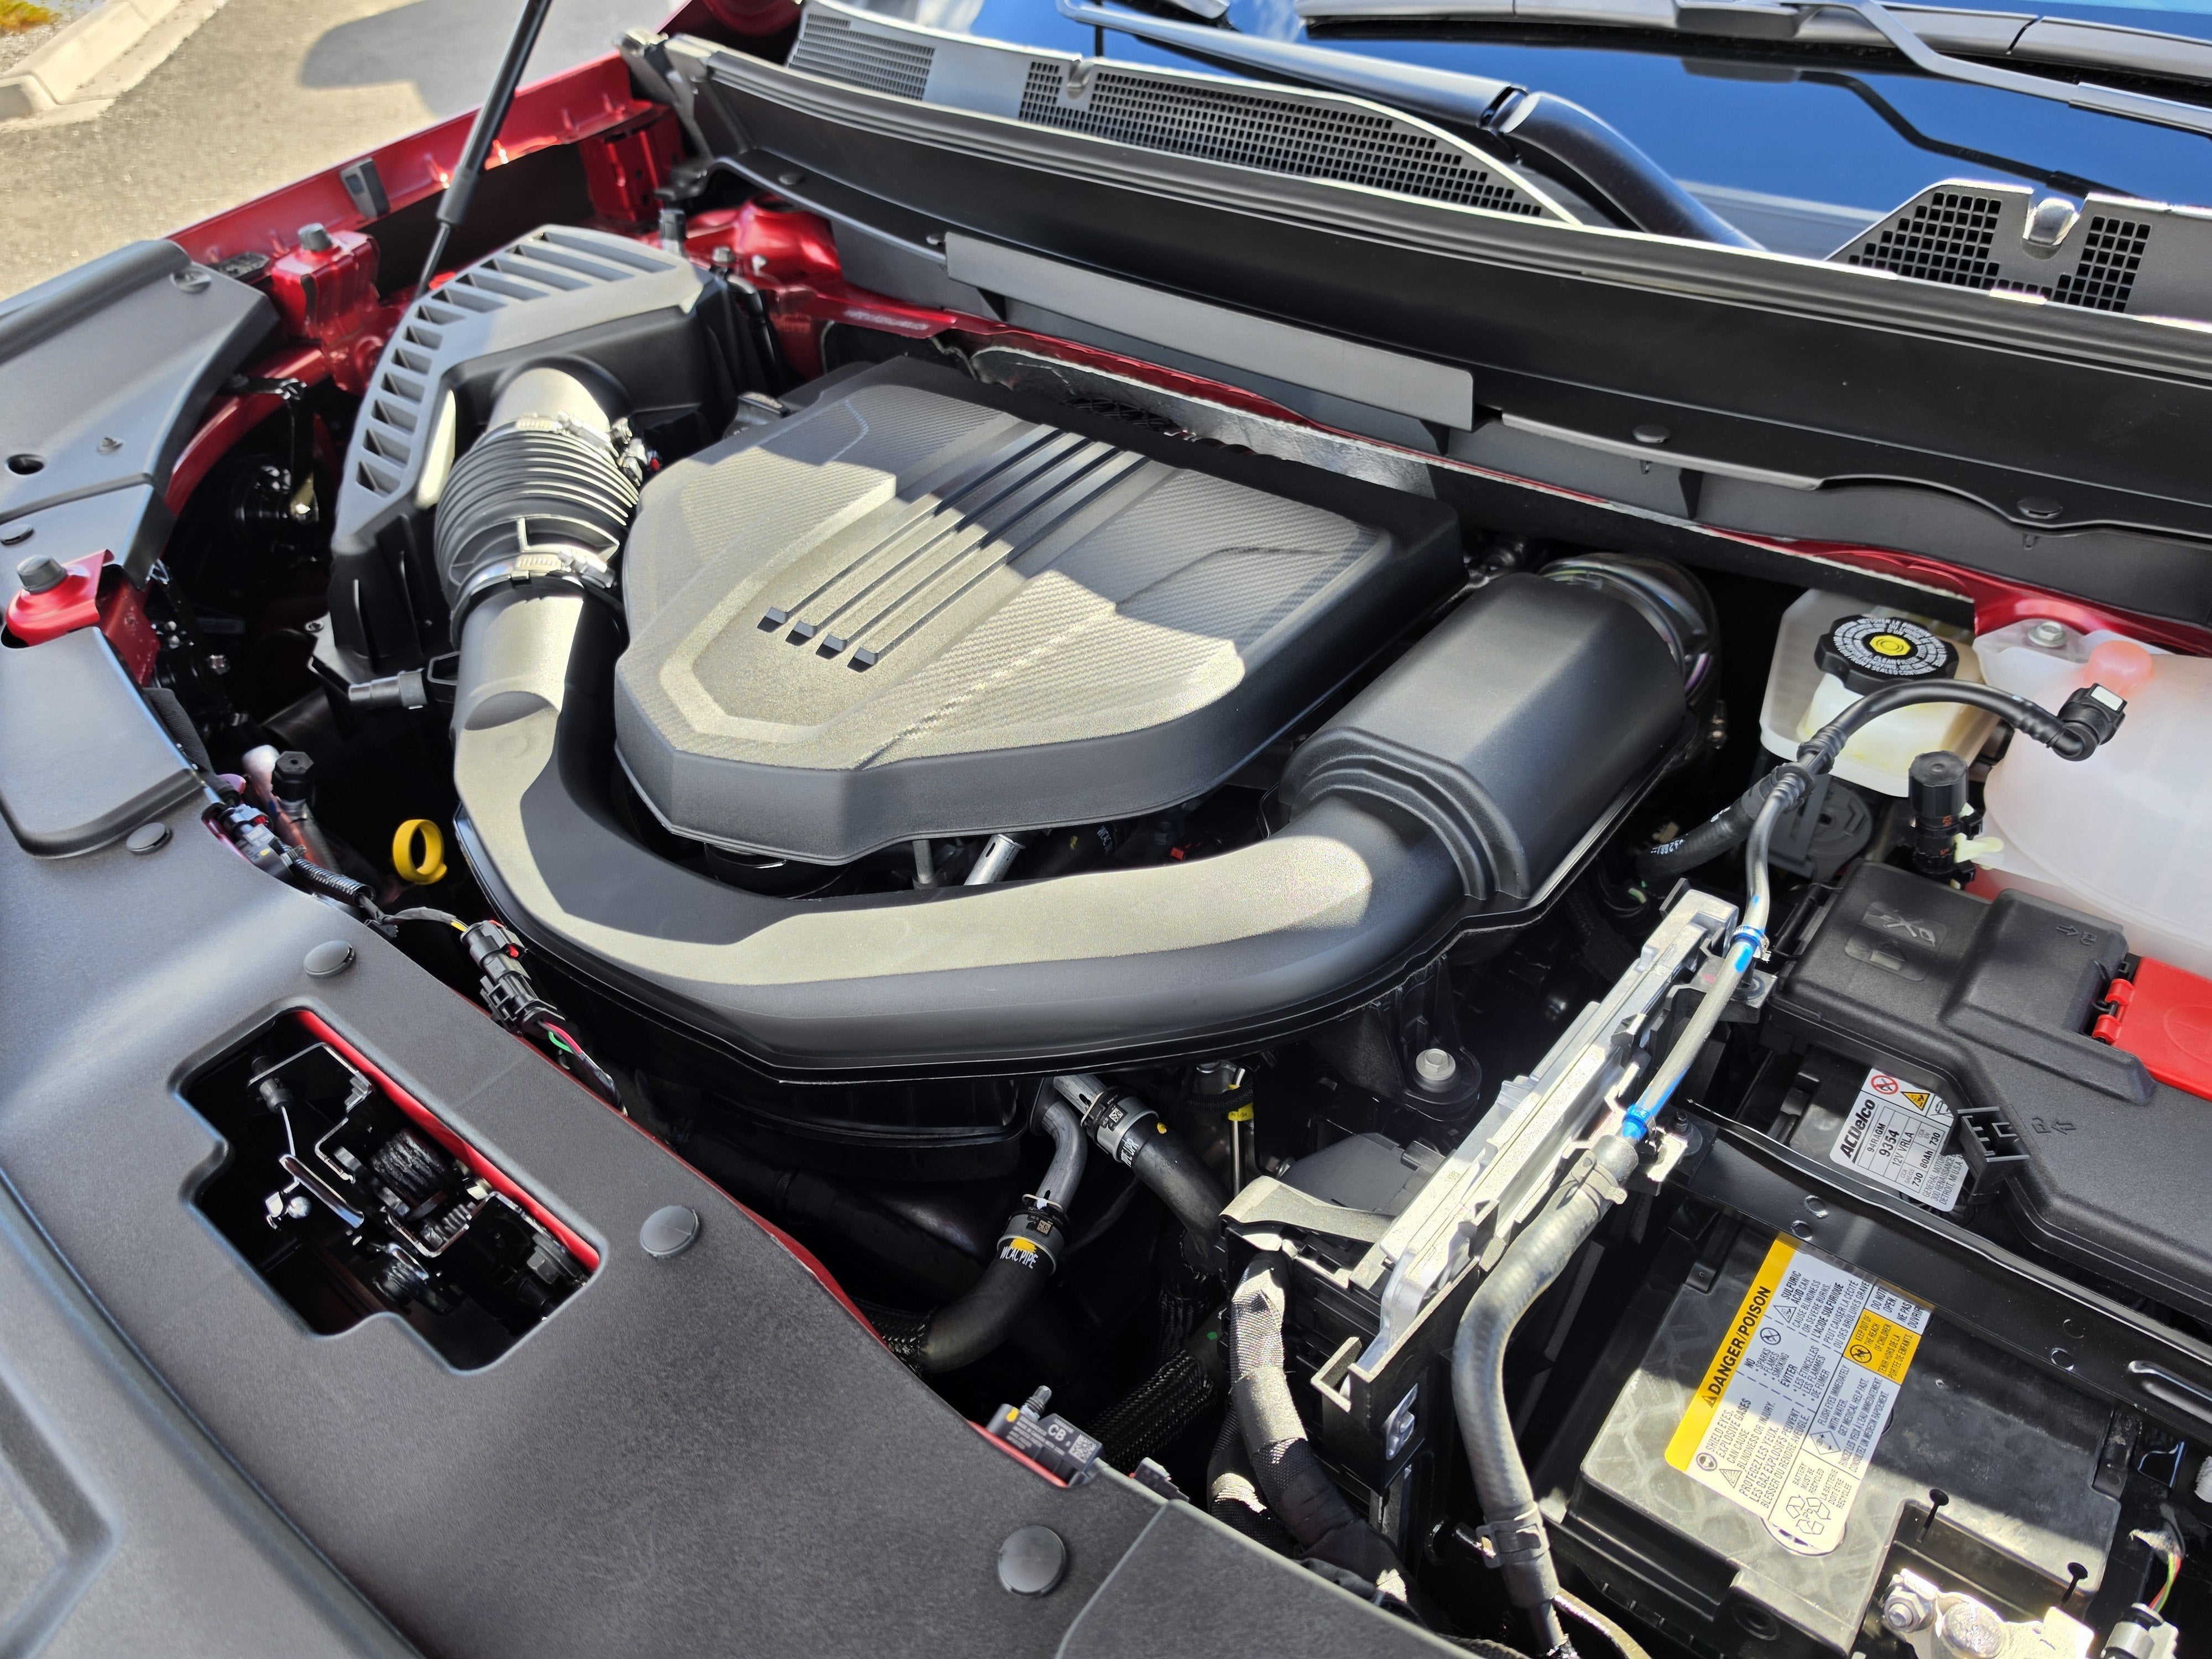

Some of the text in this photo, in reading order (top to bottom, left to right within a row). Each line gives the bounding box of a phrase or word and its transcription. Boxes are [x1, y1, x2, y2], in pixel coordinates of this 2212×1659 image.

[1871, 665, 1898, 675] SEALED
[1839, 1098, 1875, 1159] ACDelco
[1866, 1122, 1886, 1153] 94RAGM
[1929, 1131, 1941, 1146] 730
[1878, 1128, 1900, 1158] 9354
[1891, 1129, 1914, 1167] 12V VRLA
[1919, 1149, 1933, 1168] 80Ah
[1951, 1159, 1963, 1175] U.S.A.
[1911, 1171, 1923, 1187] 730
[1921, 1153, 1946, 1198] GENERAL MOTOR
[1934, 1156, 1954, 1192] RENAISSANCE
[1948, 1173, 1957, 1182] MI
[1931, 1190, 1940, 1202] 300
[1939, 1180, 1954, 1205] DETROIT,
[999, 1246, 1039, 1269] WCAC PIPE
[1781, 1270, 1801, 1300] SULFURIC
[1791, 1277, 1811, 1305] ACID CAN
[1870, 1288, 1887, 1310] DO NOT
[1792, 1279, 1821, 1328] CAUSE BLINDNESS
[1801, 1281, 1832, 1333] OR SEVERE BURNS.
[1811, 1281, 1844, 1339] L'ACIDE SULFURIQUE
[1823, 1280, 1859, 1344] PEUT CAUSER LA CÉCITÉ
[1842, 1298, 1861, 1329] BRÛLURES
[1882, 1295, 1897, 1313] OPEN.
[1896, 1301, 1912, 1322] NE PAS
[1706, 1284, 1771, 1396] DANGER/POISON
[1837, 1327, 1848, 1340] DES
[1855, 1314, 1872, 1342] KEEP OUT OF
[1864, 1322, 1880, 1347] THE REACH
[1874, 1321, 1893, 1352] OF CHILDREN.
[1833, 1338, 1843, 1349] OU
[1877, 1333, 1901, 1374] TENIR HORS DE LA
[1895, 1353, 1904, 1362] DE
[1897, 1332, 1913, 1355] ENFANTS.
[1744, 1357, 1755, 1369] NO
[1755, 1347, 1771, 1369] SPARKS
[1763, 1351, 1780, 1374] FLAMES
[1771, 1352, 1790, 1378] SMOKING
[1793, 1345, 1819, 1390] LES ÉTINCELLES
[1778, 1363, 1798, 1388] ÉVITER
[1801, 1354, 1826, 1394] LES FLAMMES
[1811, 1368, 1830, 1399] DE FUMER
[1817, 1364, 1850, 1426] FLUSH EYES IMMEDIATELY
[1838, 1376, 1869, 1436] GET MEDICAL HELP FAST.
[1861, 1376, 1883, 1413] IMMÉDIATEMENT.
[1715, 1397, 1751, 1458] EXPLOSIVE GASES
[1827, 1396, 1848, 1431] WITH WATER.
[1856, 1411, 1868, 1426] L'EAU
[1048, 1423, 1066, 1441] CB
[1704, 1407, 1734, 1453] SHIELD EYES.
[1736, 1400, 1776, 1470] BLINDNESS OR INJURY.
[1848, 1390, 1890, 1473] CONSULTEZ UN MÉDECIN RAPIDEMENT.
[1849, 1427, 1861, 1442] YEUX
[1726, 1427, 1750, 1464] CAN CAUSE
[1749, 1407, 1801, 1503] LES GAZ EXPLOSIFS PEUVENT
[1838, 1448, 1852, 1467] RINCEZ
[1845, 1439, 1856, 1451] LES
[1739, 1424, 1779, 1496] PROTÉGEZ LES YEUX.
[1760, 1412, 1811, 1509] BLESSER OU RENDRE AVEUGLE.
[1792, 1461, 1808, 1485] BATTERY
[1800, 1467, 1814, 1490] MUST BE
[1808, 1467, 1825, 1494] RECYCLED
[1819, 1468, 1838, 1500] LA BATTERIE
[1828, 1491, 1838, 1505] DOIT
[1803, 1506, 1813, 1519] Pb
